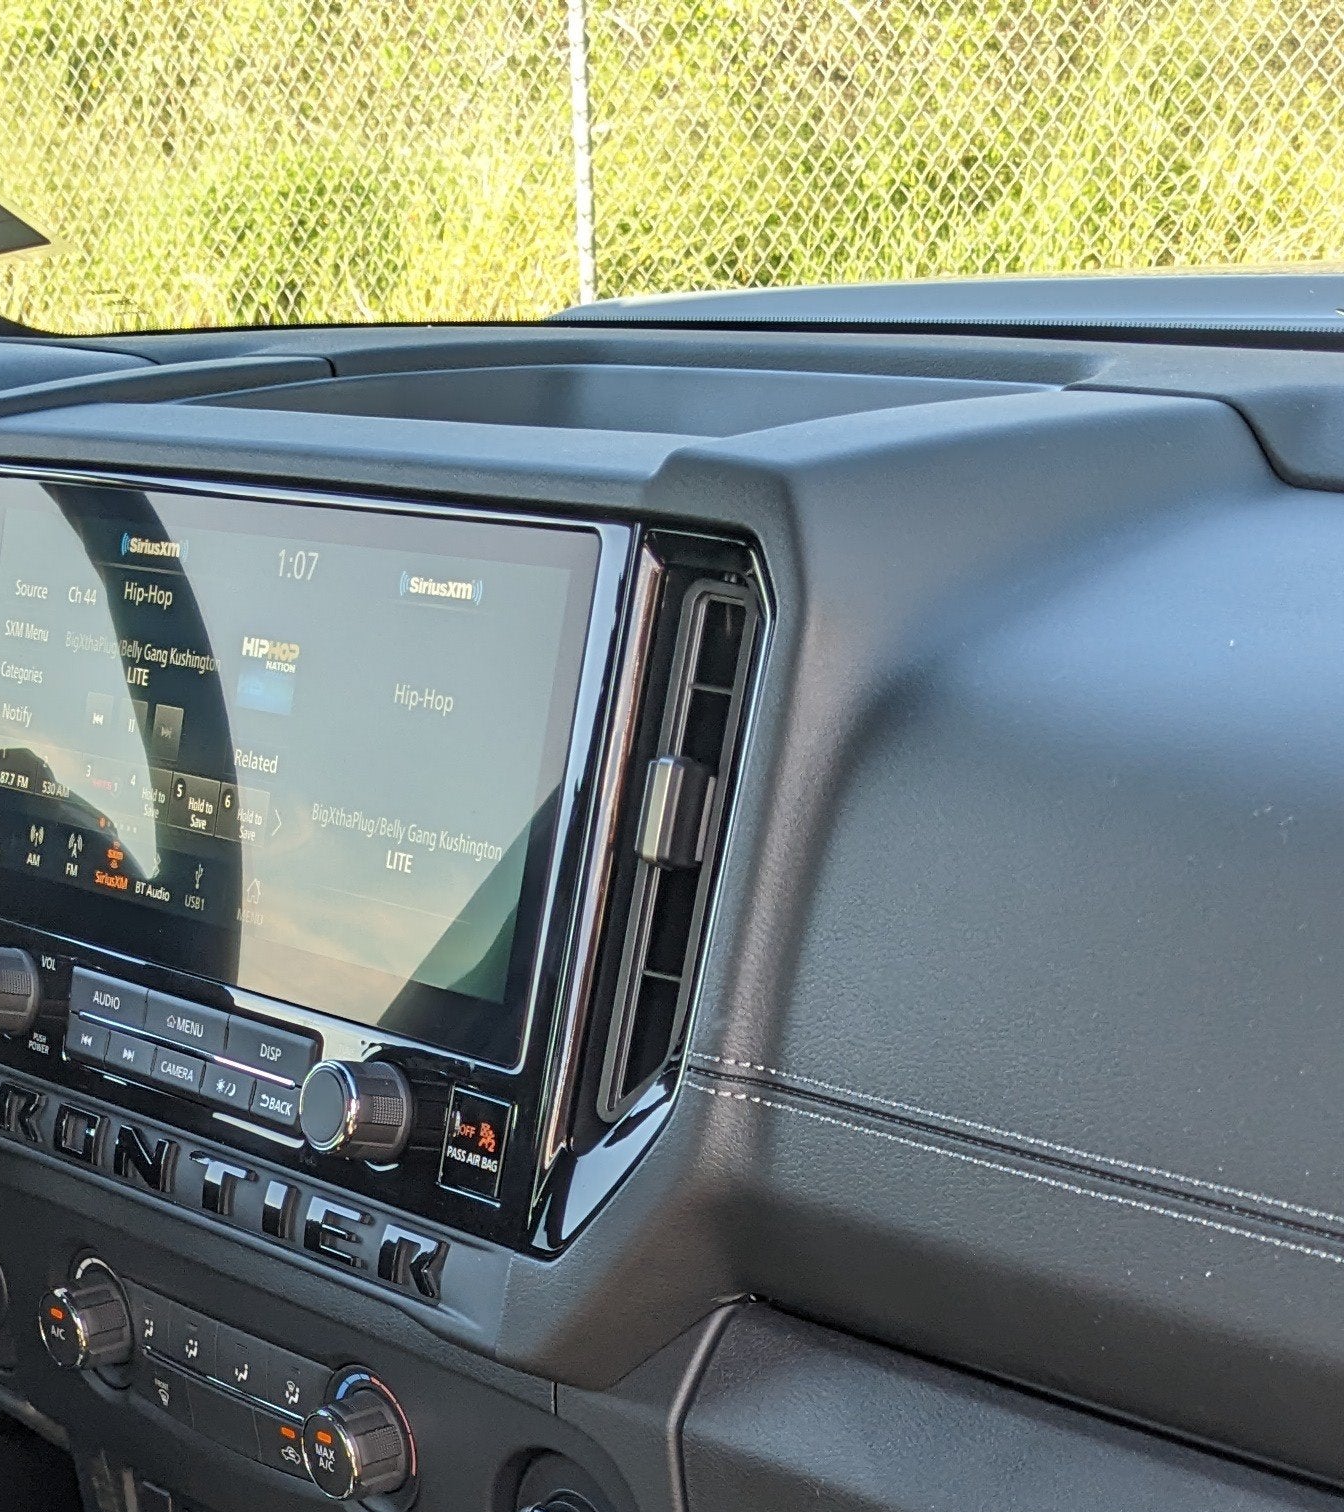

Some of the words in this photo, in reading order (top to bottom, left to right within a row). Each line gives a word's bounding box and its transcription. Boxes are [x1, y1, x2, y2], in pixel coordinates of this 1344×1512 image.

[278, 548, 320, 581] 1:07
[15, 579, 49, 600] Source
[68, 586, 82, 603] Ch
[84, 588, 97, 606] 44
[124, 581, 173, 610] Hip-Hop
[5, 619, 23, 638] SXM
[26, 622, 49, 643] Menu
[144, 643, 169, 668] Gang
[169, 647, 221, 674] Kushington
[266, 660, 296, 673] NATION
[1, 661, 43, 685] Categories
[127, 667, 150, 686] LITE
[394, 683, 454, 716] Hip-Hop
[2, 703, 33, 728] Notify
[85, 764, 92, 778] 3
[233, 749, 279, 774] Related
[17, 775, 29, 789] FM
[176, 784, 183, 798] 5
[142, 787, 158, 802] Hold
[158, 792, 166, 804] to
[224, 795, 231, 808] 6
[144, 803, 160, 819] Save
[188, 797, 205, 813] Hold
[205, 802, 213, 815] to
[190, 814, 207, 830] Save
[237, 809, 254, 825] Hold
[254, 814, 263, 826] to
[239, 826, 256, 842] Save
[312, 803, 406, 845] BigXthaPlug/Belly
[408, 824, 437, 852] Gang
[439, 830, 503, 862] Kushington
[26, 852, 41, 868] AM
[65, 862, 78, 877] FM
[386, 850, 414, 874] LITE
[95, 871, 129, 890] SiriusXM
[135, 881, 146, 895] BT
[146, 884, 171, 902] Audio
[184, 894, 205, 911] USB1
[41, 954, 56, 971] VOL
[92, 990, 121, 1011] AUDIO
[176, 1018, 205, 1038] MENU
[28, 1040, 50, 1055] POWER
[260, 1043, 282, 1062] DISP
[160, 1060, 195, 1083] CAMERA
[268, 1096, 293, 1117] BACK
[460, 1123, 476, 1139] OFF
[446, 1145, 467, 1163] PASS
[465, 1152, 481, 1168] AIR
[480, 1156, 498, 1173] BAG
[50, 1324, 66, 1341] A/C
[315, 1442, 336, 1461] MAX
[318, 1457, 336, 1473] A/C
